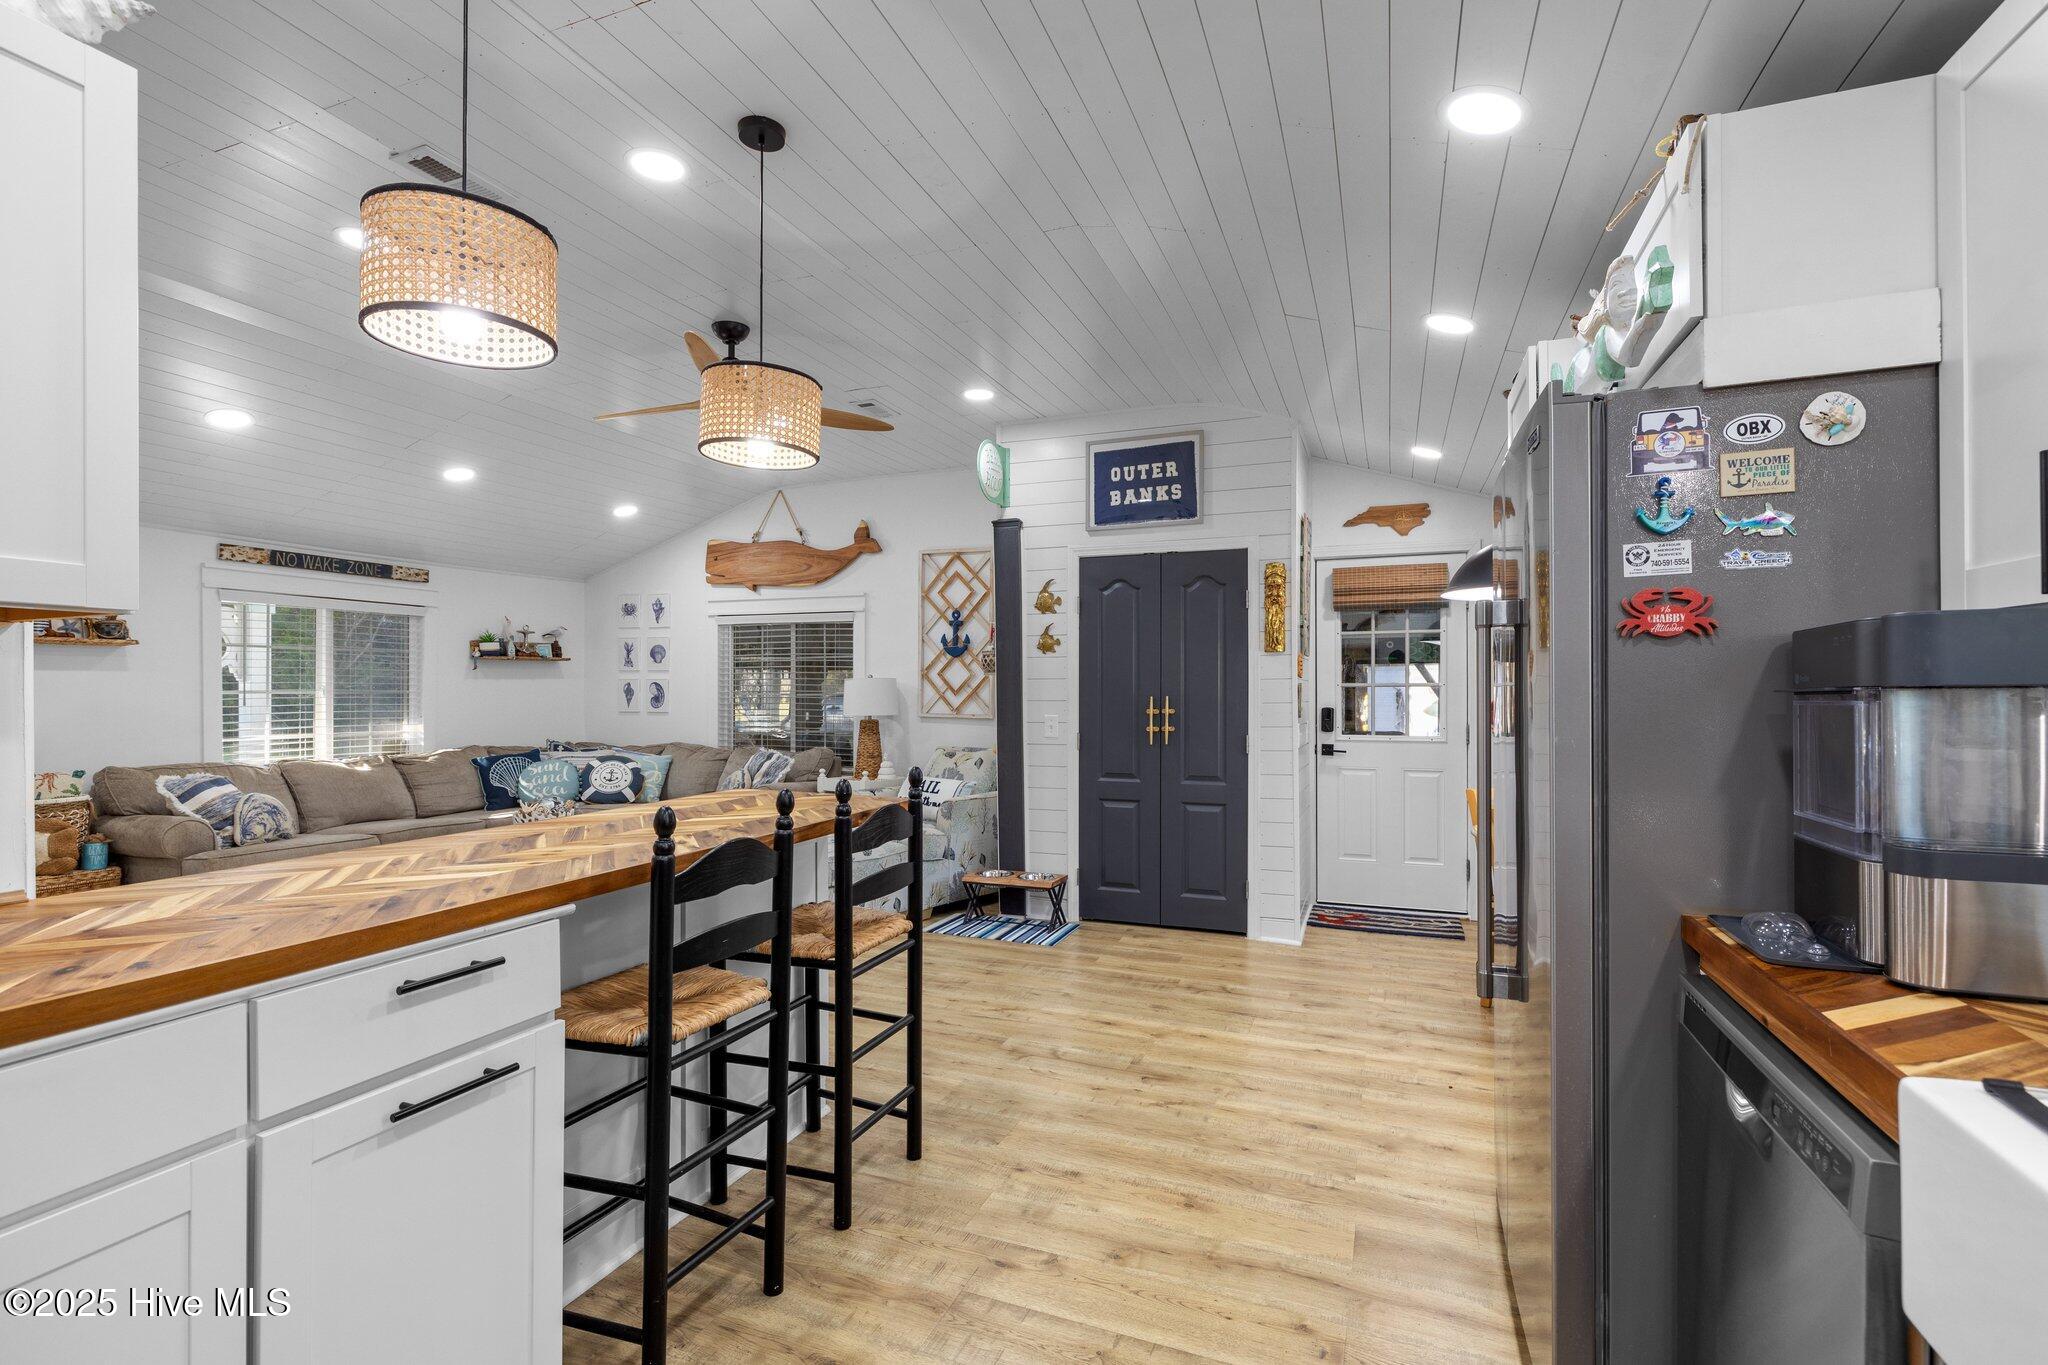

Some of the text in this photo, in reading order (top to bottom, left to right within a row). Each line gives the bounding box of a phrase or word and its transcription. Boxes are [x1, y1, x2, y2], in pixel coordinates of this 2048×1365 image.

[1737, 419, 1771, 436] OBX
[1727, 455, 1790, 468] WELCOME
[1110, 461, 1179, 482] OUTER
[1752, 476, 1790, 487] Paradise
[1110, 484, 1181, 506] BANKS
[276, 553, 382, 577] NO WAKE ZONE
[1651, 558, 1690, 567] 740-591-5554
[1647, 613, 1686, 623] CRABBY
[920, 779, 941, 794] AIL
